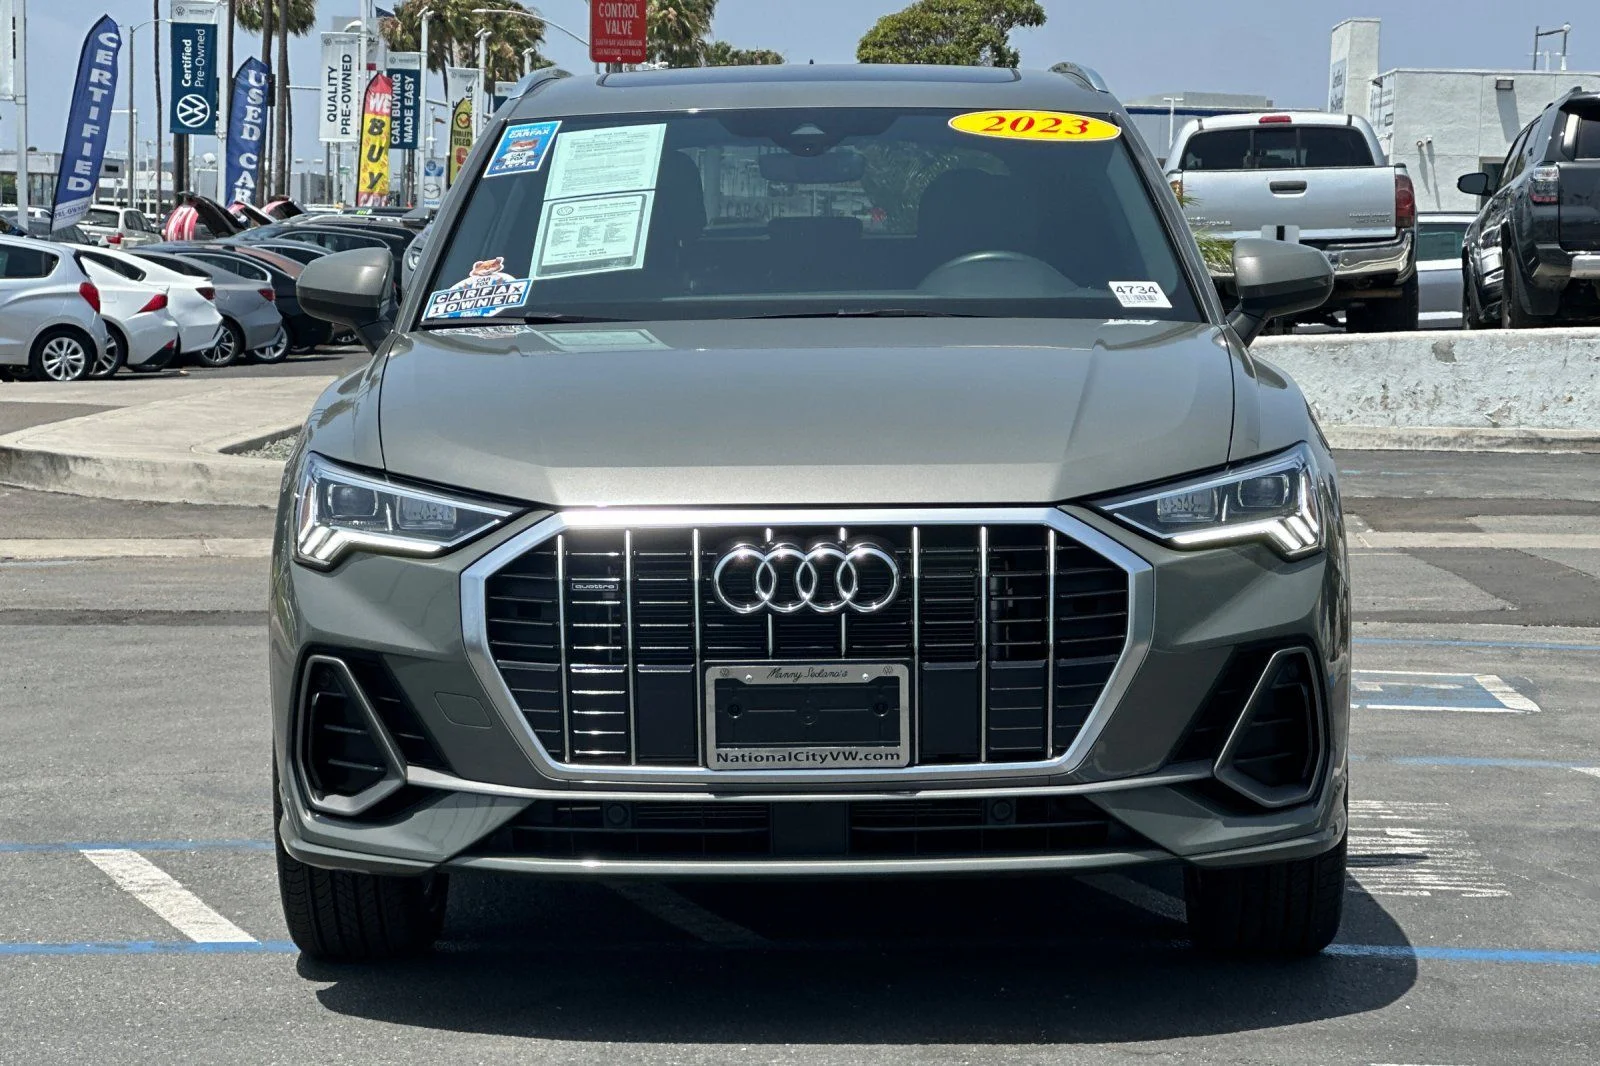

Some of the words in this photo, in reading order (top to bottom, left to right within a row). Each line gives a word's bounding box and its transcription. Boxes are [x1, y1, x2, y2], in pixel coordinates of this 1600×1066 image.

[598, 3, 640, 19] CONTROL
[605, 20, 633, 35] VALVE
[181, 38, 193, 88] Certified
[194, 28, 206, 88] Pre-Owned
[327, 65, 338, 123] QUALITY
[341, 53, 352, 136] PRE-OWNED
[391, 73, 402, 117] BUYING
[404, 75, 415, 106] EASY
[67, 32, 119, 192] CERTIFIED
[240, 69, 267, 141] USED
[369, 92, 392, 114] WE
[391, 119, 401, 145] CAR
[403, 109, 414, 143] MADE
[508, 129, 550, 139] CARFAX
[983, 115, 1090, 135] 2023
[366, 117, 386, 190] BUY
[454, 138, 471, 147] USED
[436, 283, 525, 304] CARFAX
[1116, 285, 1158, 295] 4734
[446, 295, 521, 312] OWNER
[767, 667, 803, 683] Manny
[715, 751, 900, 764] NationalCityVW.com
